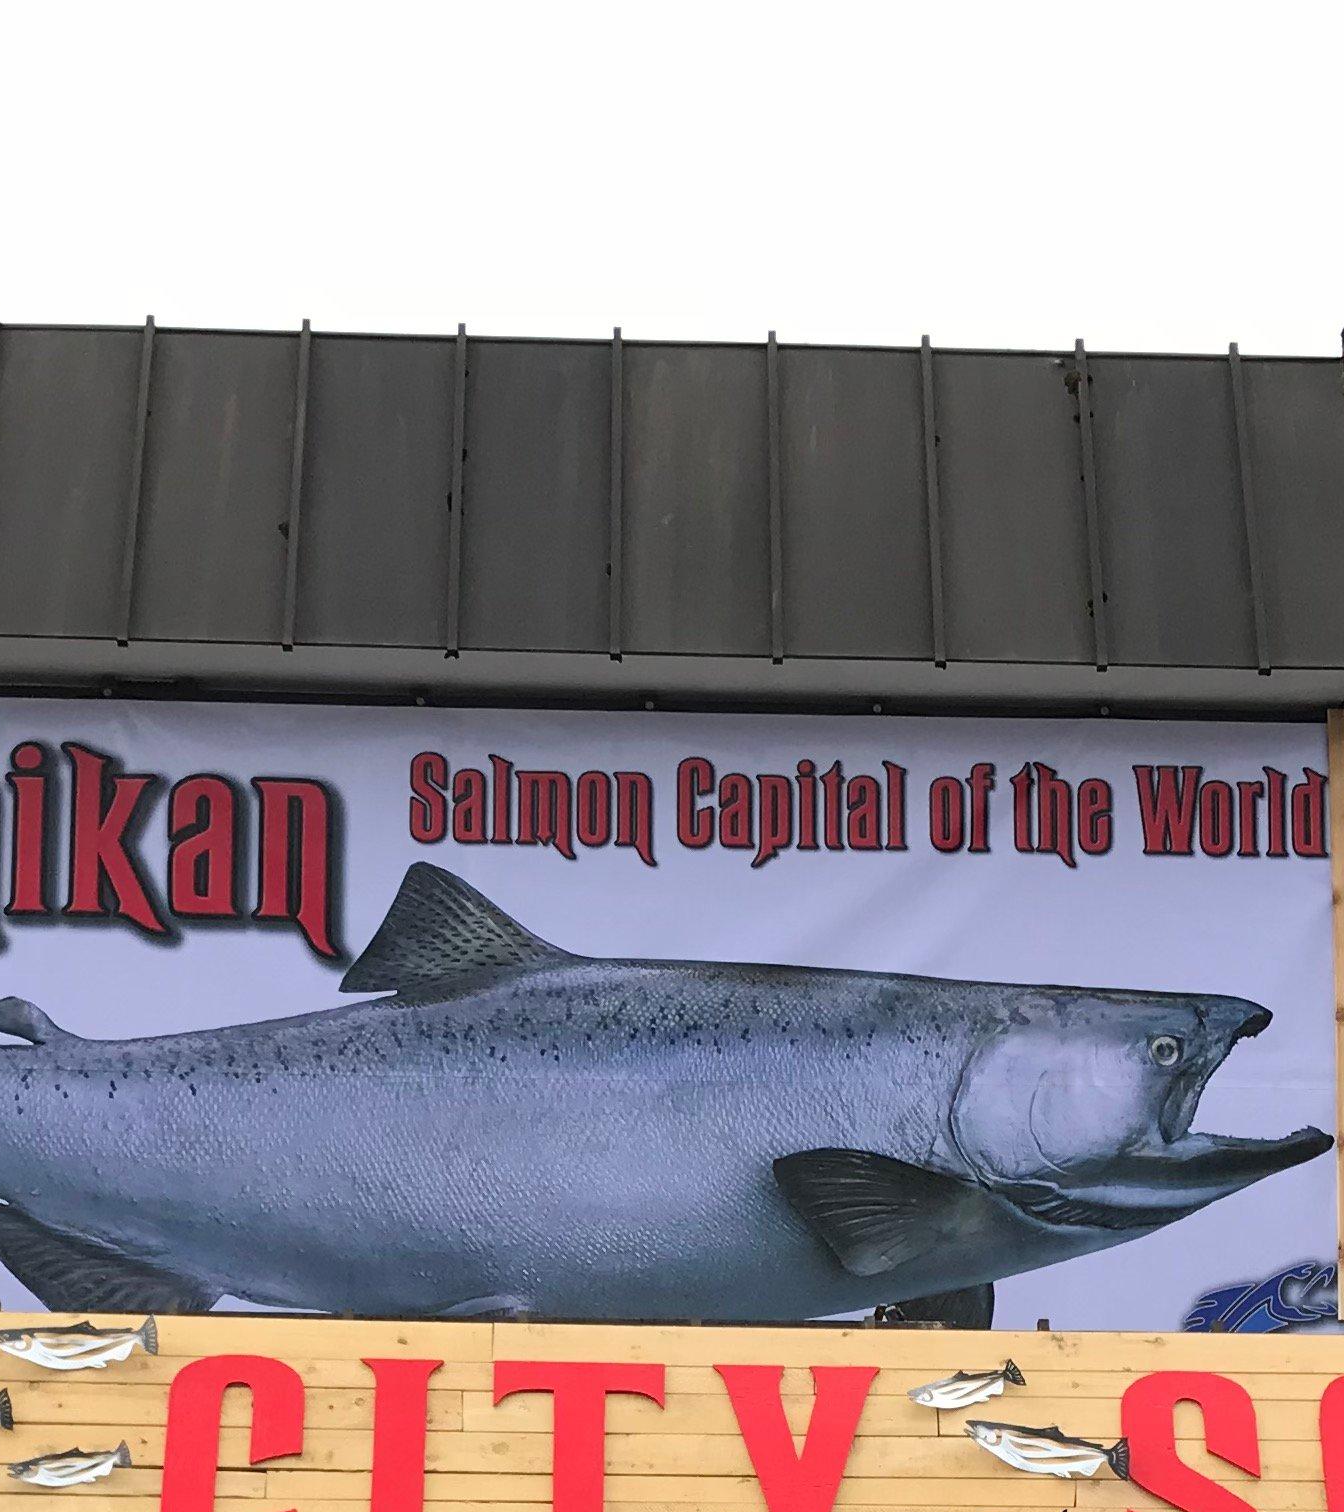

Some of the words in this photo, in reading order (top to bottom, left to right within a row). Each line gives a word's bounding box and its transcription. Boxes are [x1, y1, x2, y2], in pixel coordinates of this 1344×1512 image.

[409, 752, 657, 866] Salmon
[676, 756, 907, 867] Capital
[929, 762, 996, 852] of
[1011, 762, 1112, 868] the
[1133, 764, 1328, 857] World
